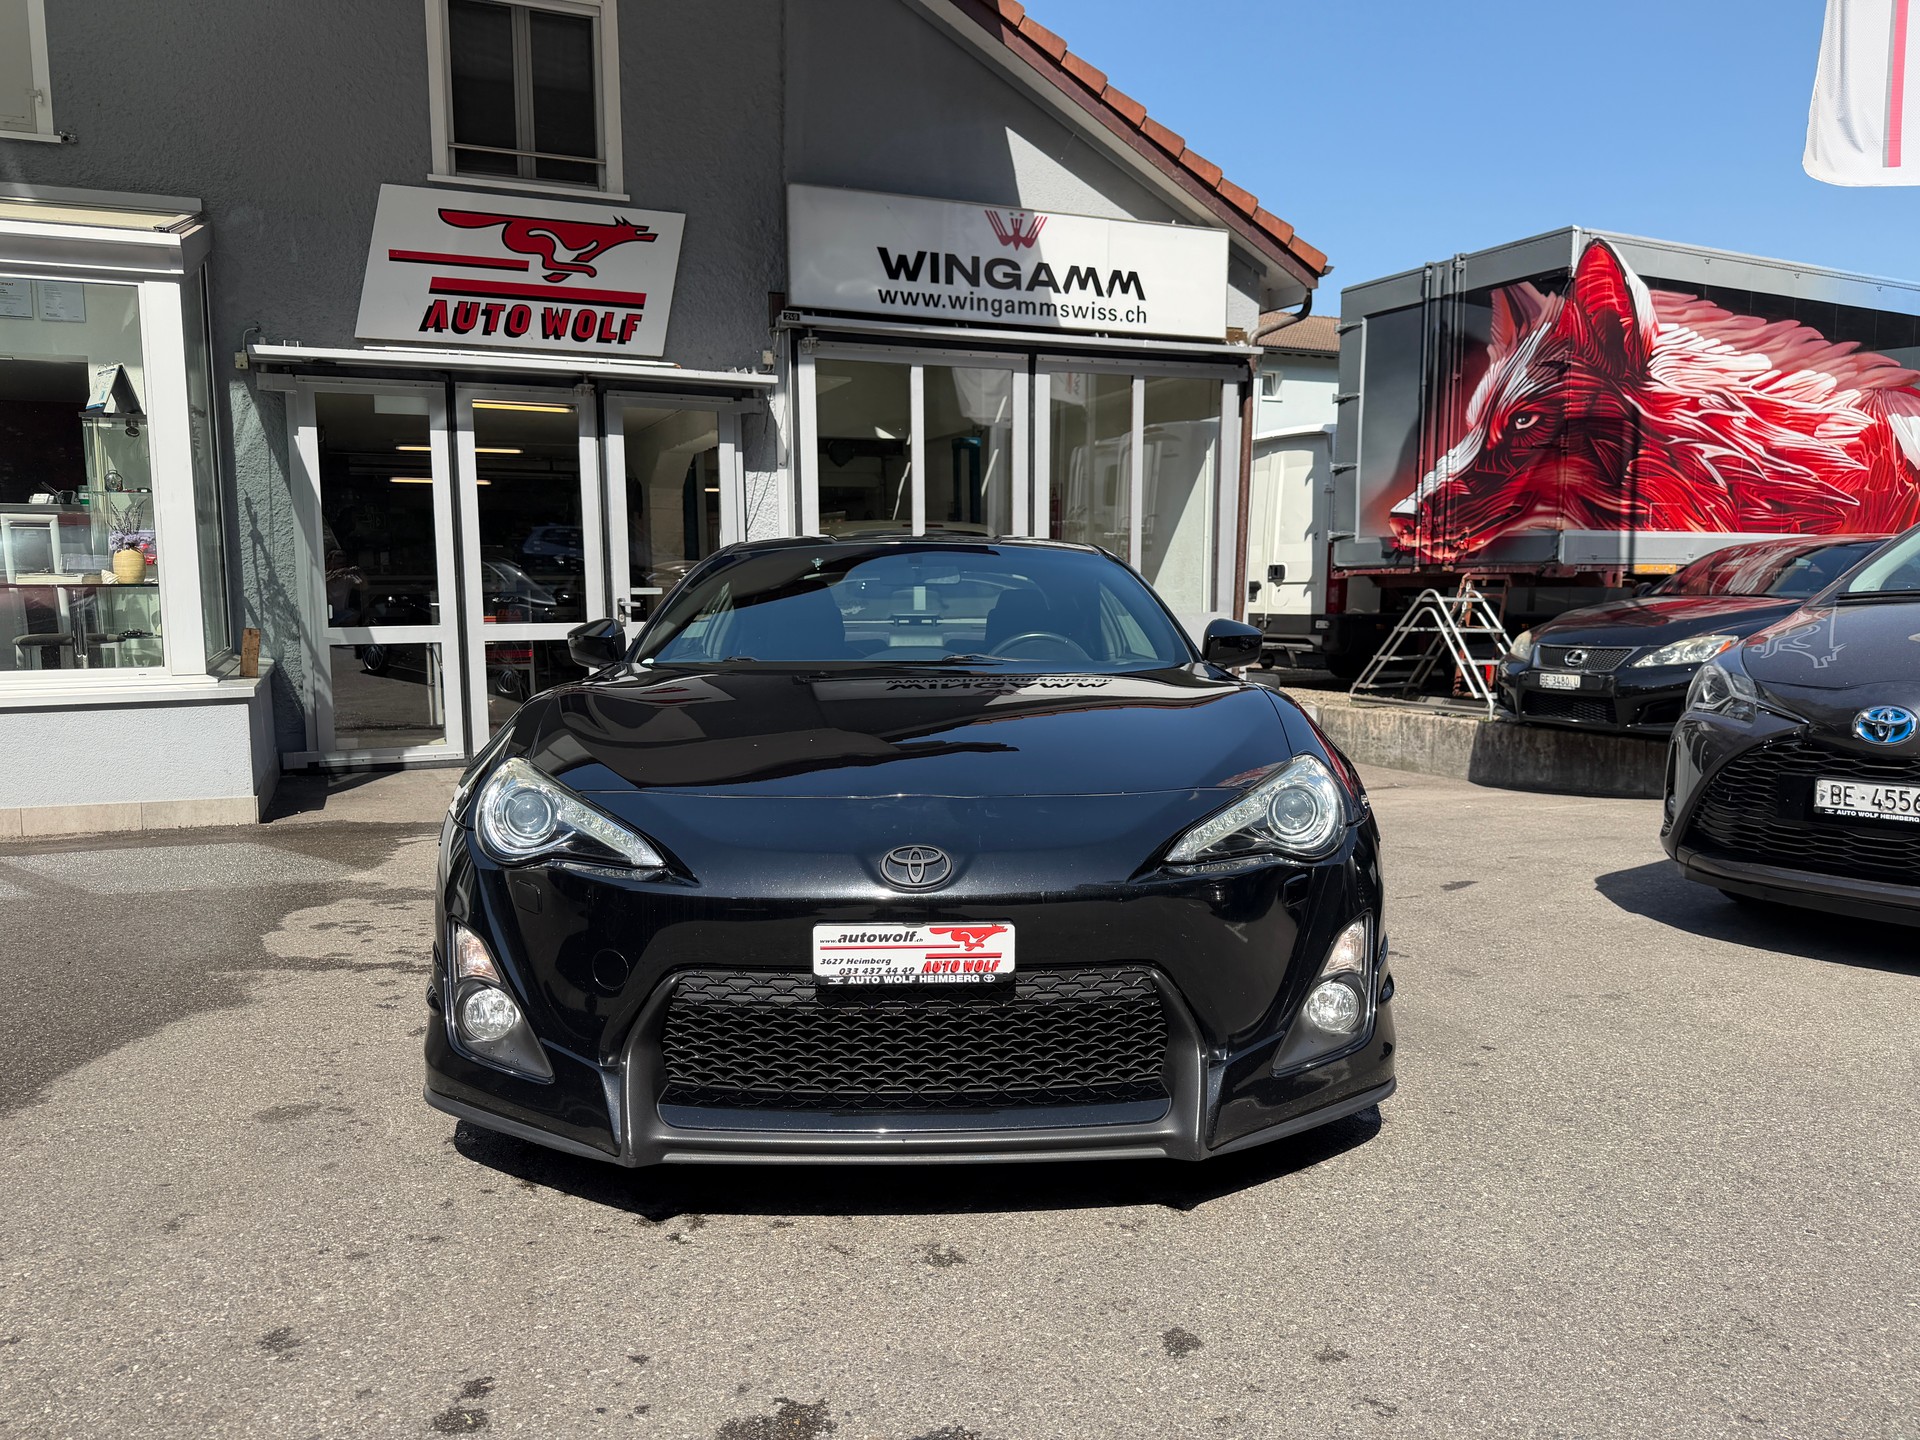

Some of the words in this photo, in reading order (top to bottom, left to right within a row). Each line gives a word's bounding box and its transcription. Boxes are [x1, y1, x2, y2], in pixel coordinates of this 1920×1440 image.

[877, 246, 1147, 301] WINGAMM
[877, 288, 1147, 324] www.wingammswiss.ch
[418, 299, 532, 338] AUTO
[541, 307, 642, 345] WOLF
[1836, 809, 1857, 817] AUTO
[1858, 811, 1879, 819] WOLF
[1880, 813, 1920, 823] HEIMBERG
[820, 931, 924, 944] www.autowolf.ch
[846, 957, 892, 966] Heimberg
[921, 960, 960, 973] AUTO
[963, 960, 1001, 973] WOLF
[838, 967, 859, 975] 033
[861, 967, 882, 975] 437
[885, 967, 898, 975] 44
[847, 975, 880, 984] AUTO
[883, 975, 916, 984] WOLF
[919, 974, 980, 983] HEIMBERG
